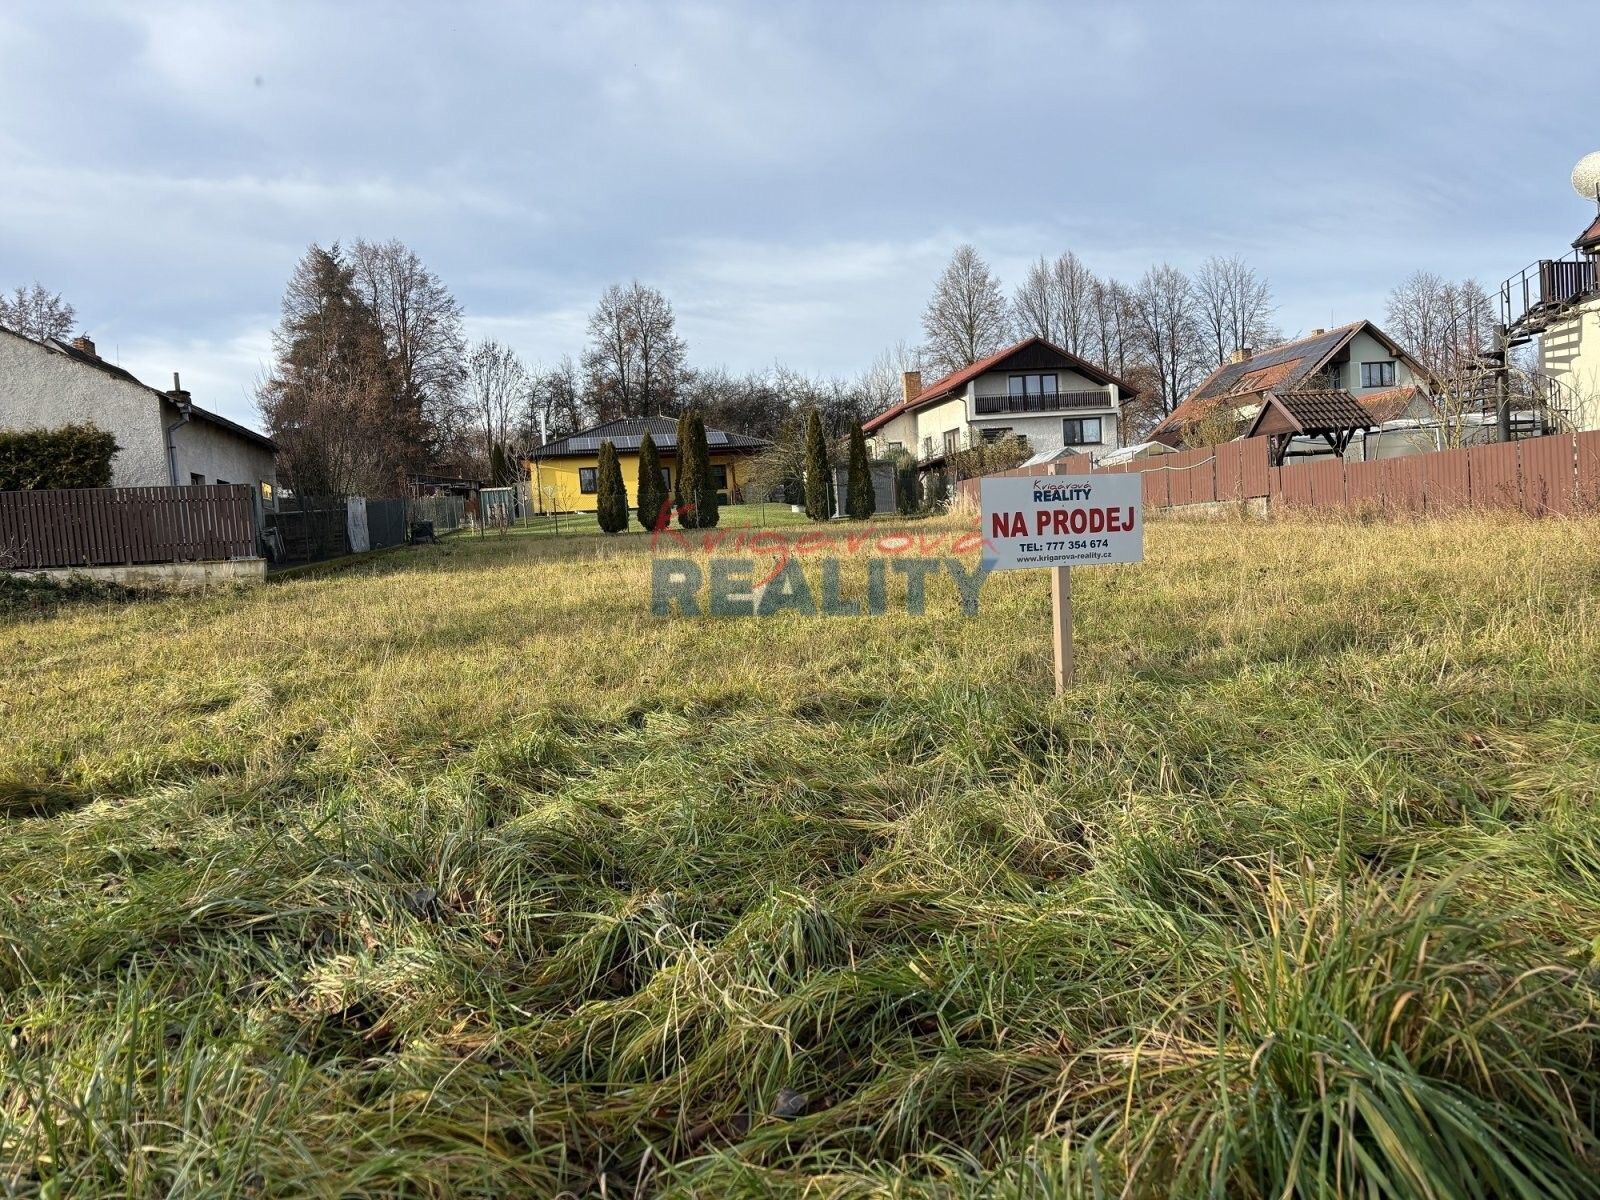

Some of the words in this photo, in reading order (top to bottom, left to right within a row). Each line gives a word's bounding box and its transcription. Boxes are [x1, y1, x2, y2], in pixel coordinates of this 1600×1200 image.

[1034, 489, 1091, 502] REALITY
[992, 512, 1028, 538] NA
[1037, 507, 1134, 535] PRODEJ
[1020, 543, 1042, 552] TEL:
[1046, 542, 1064, 550] 777
[1068, 541, 1086, 549] 354
[1090, 540, 1108, 548] 674
[1017, 552, 1112, 562] www.krigarova-reality.cz
